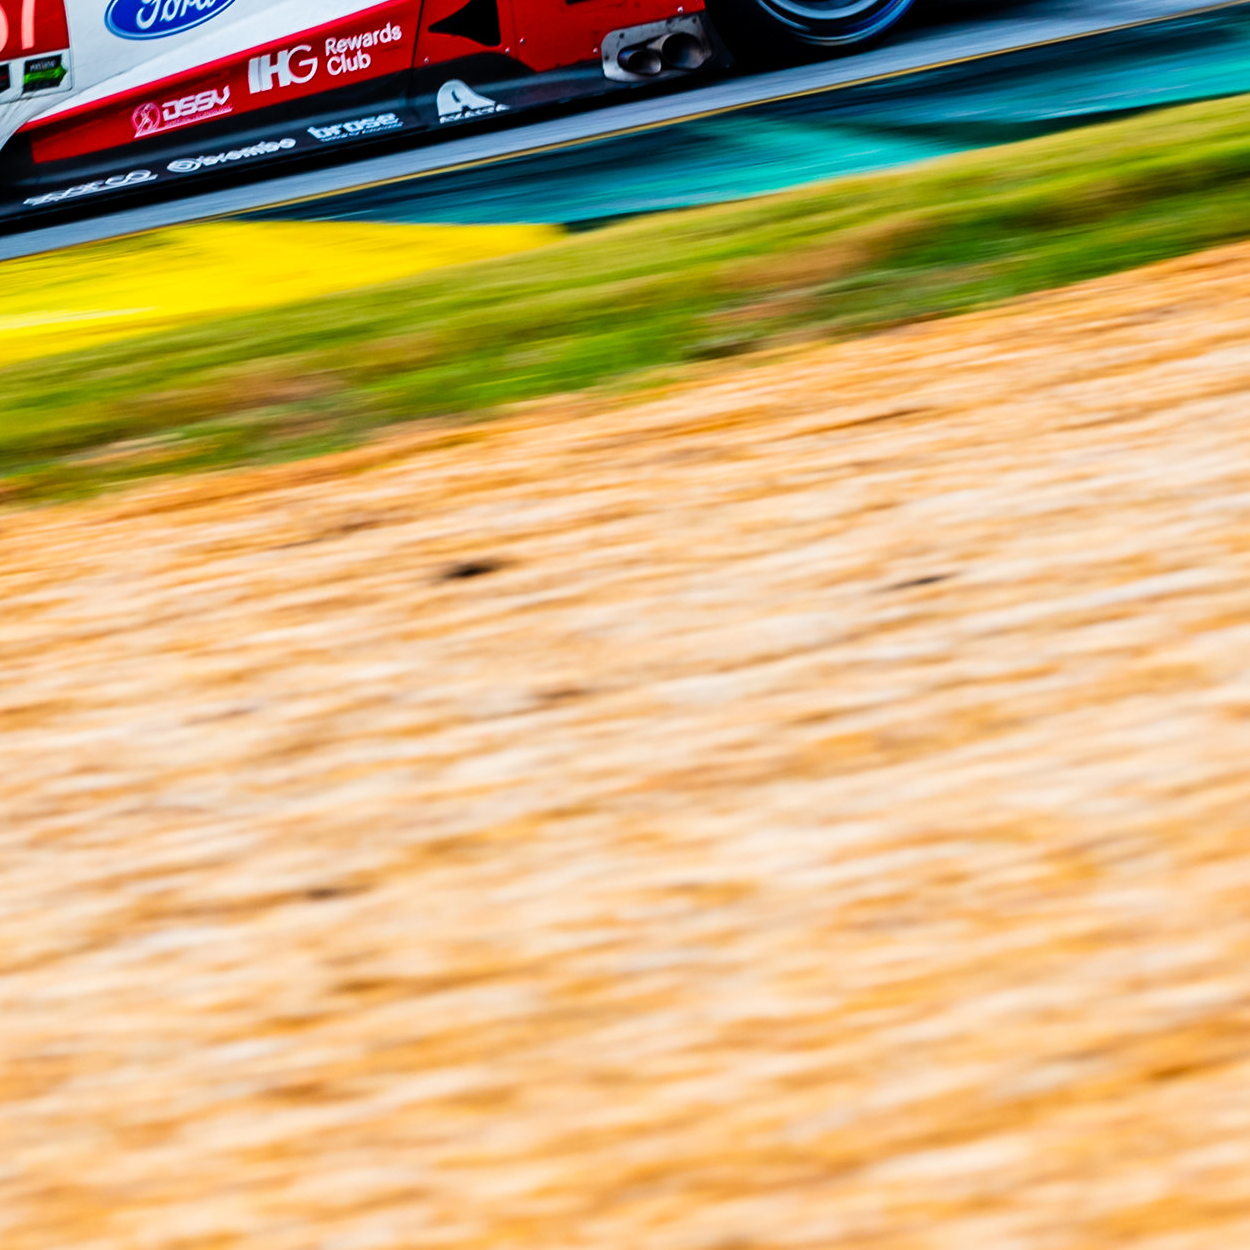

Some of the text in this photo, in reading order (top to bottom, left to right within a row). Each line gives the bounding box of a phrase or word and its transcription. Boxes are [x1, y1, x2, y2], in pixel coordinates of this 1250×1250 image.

[325, 22, 402, 56] Rewards
[248, 44, 318, 94] IHG
[326, 49, 372, 76] Club
